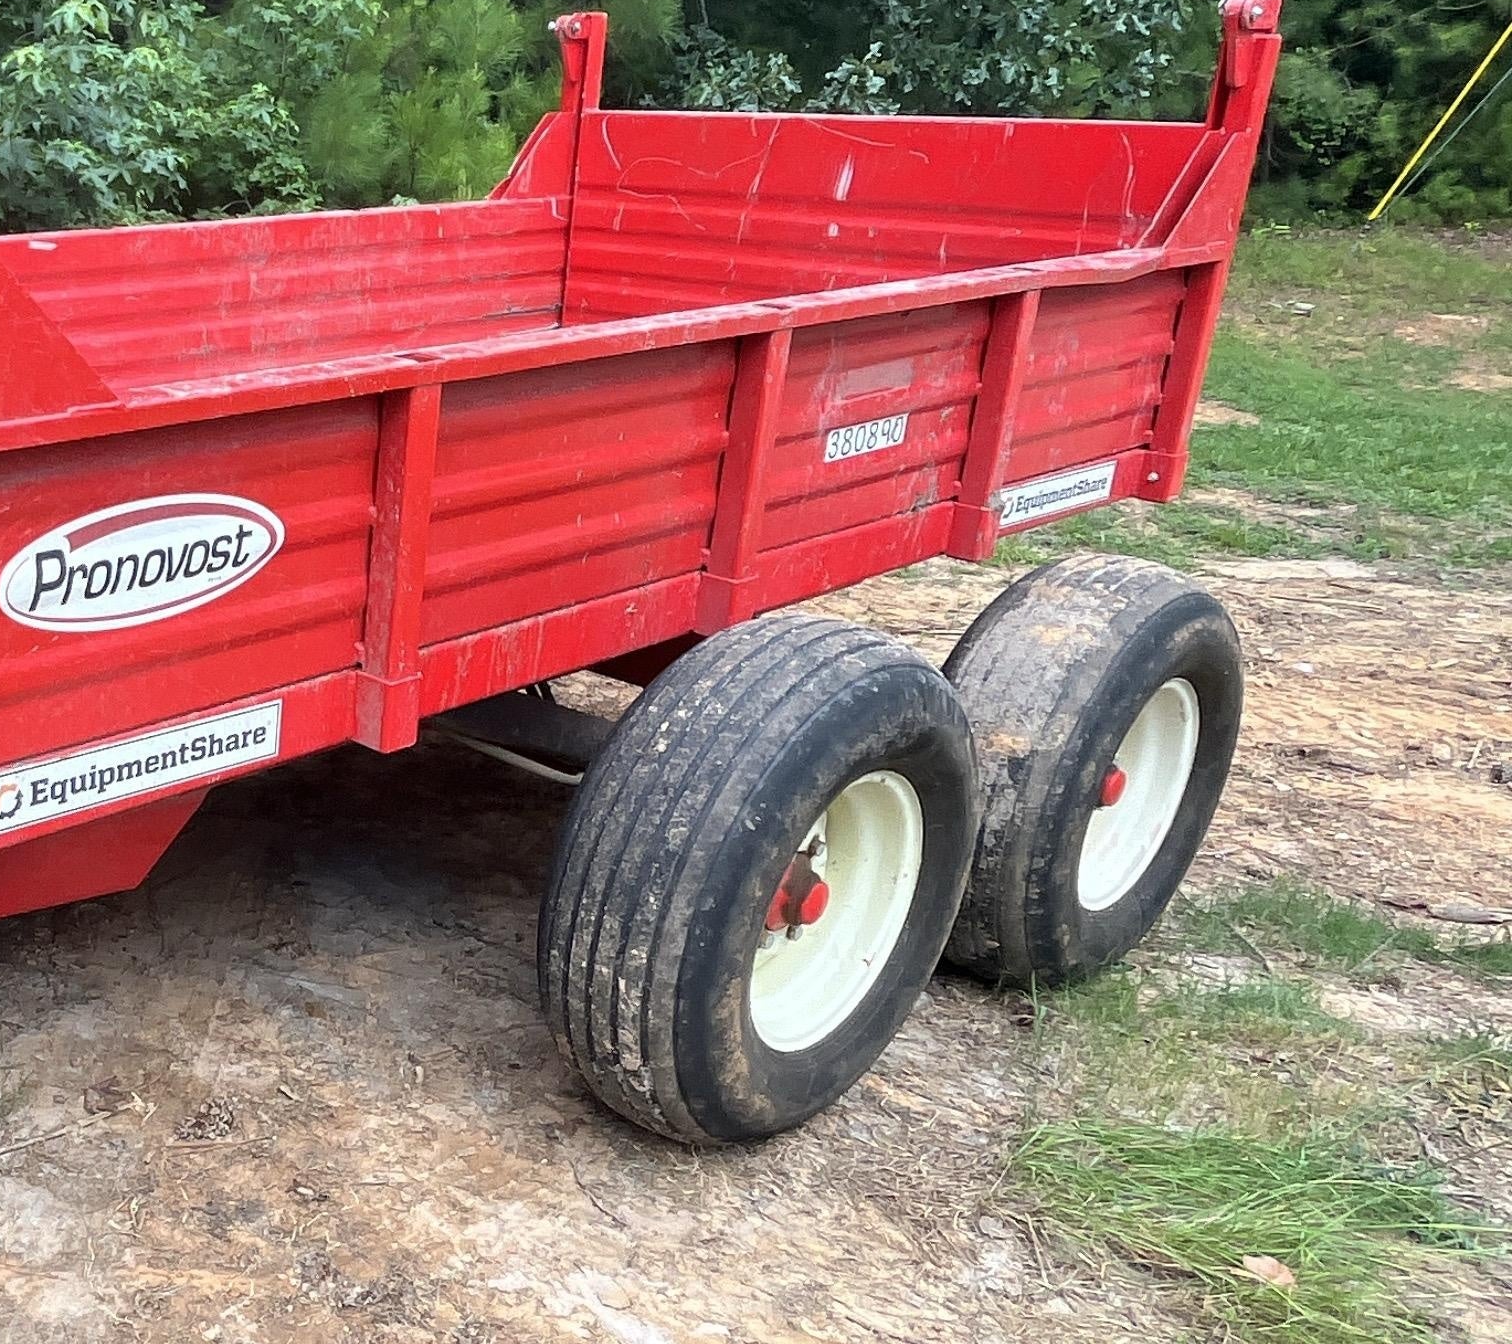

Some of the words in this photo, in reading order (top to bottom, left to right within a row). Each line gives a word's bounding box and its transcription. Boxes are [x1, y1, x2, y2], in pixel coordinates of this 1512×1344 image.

[1015, 475, 1108, 515] EquipmentShare
[29, 524, 253, 612] Pronovost
[30, 725, 267, 807] EquipmentShare
